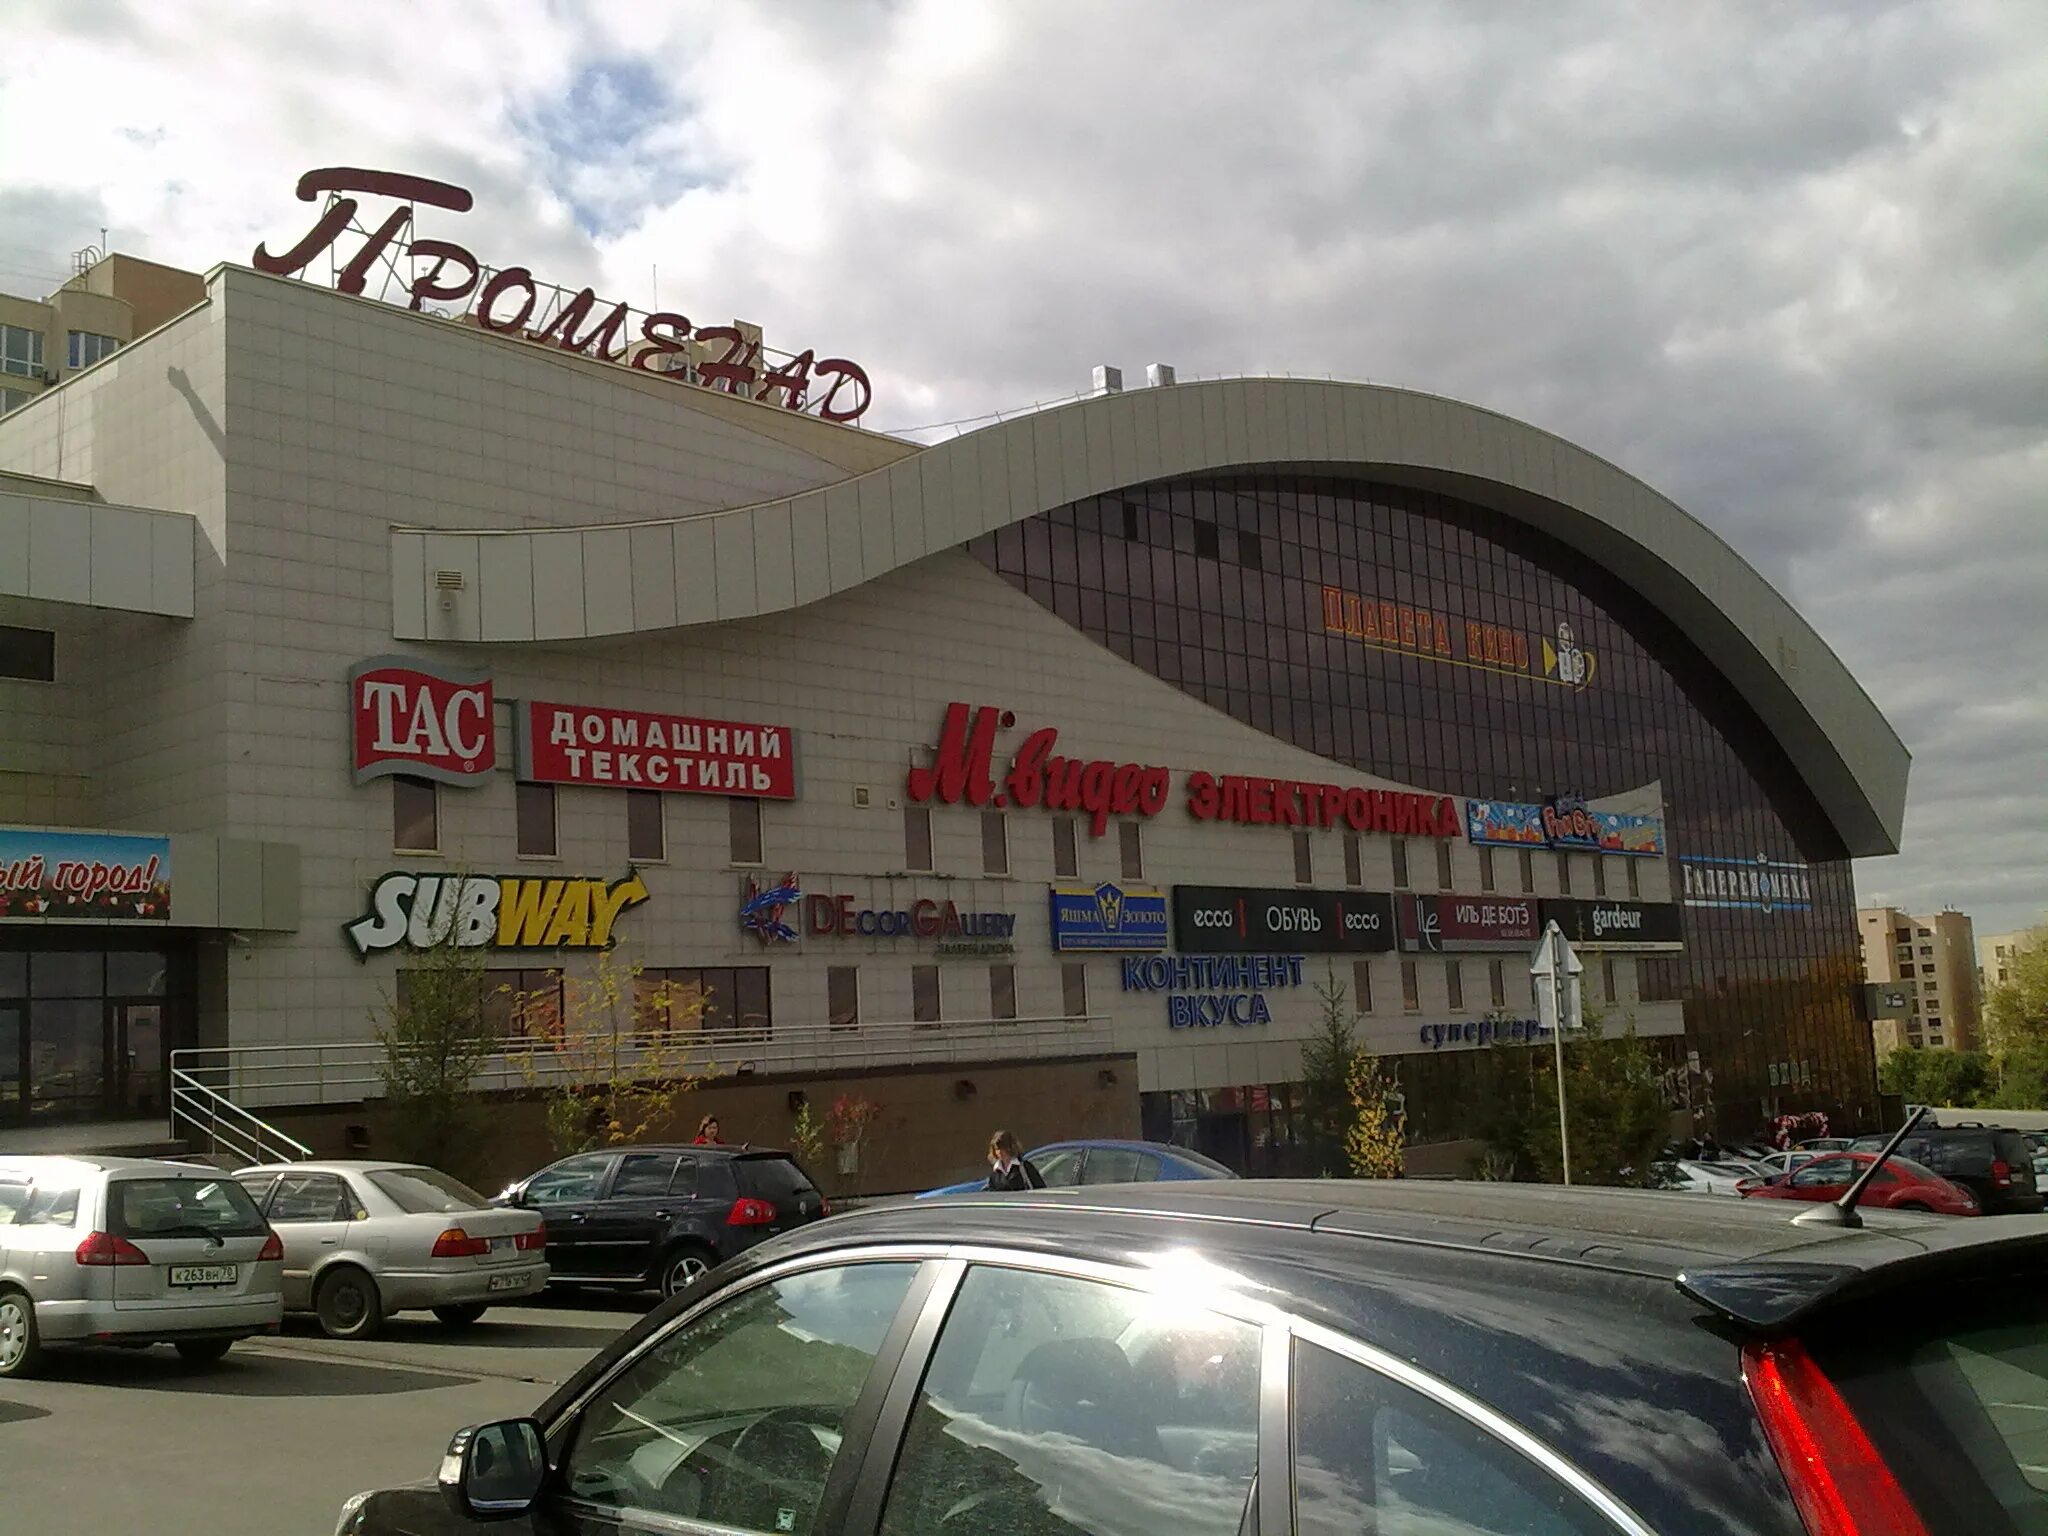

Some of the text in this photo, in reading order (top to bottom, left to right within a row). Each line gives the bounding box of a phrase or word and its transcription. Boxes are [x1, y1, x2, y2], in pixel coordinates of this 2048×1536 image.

[1321, 585, 1529, 669] ПЛАНЕТА КИНО
[363, 681, 486, 759] TAC
[551, 710, 782, 758] ДОМАШНИЙ
[564, 747, 772, 791] ТЕКСТИЛЬ
[1187, 770, 1461, 837] ЭЛЕКТРОНИКА
[53, 854, 159, 901] город!
[1683, 864, 1811, 899] ГАЛЕРЕЯ МЕХА
[349, 866, 651, 958] SUBWAY
[1060, 907, 1166, 924] ЯШМА ЗОЛОТО
[1194, 906, 1380, 933] ecco ОБУВЬ ecco
[1456, 904, 1479, 924] ИЛЬ
[1481, 905, 1498, 927] ДЕ
[1592, 904, 1642, 937] gardeur
[1122, 955, 1306, 991] КОНТИНЕНТ
[1168, 993, 1273, 1028] ВКУСА
